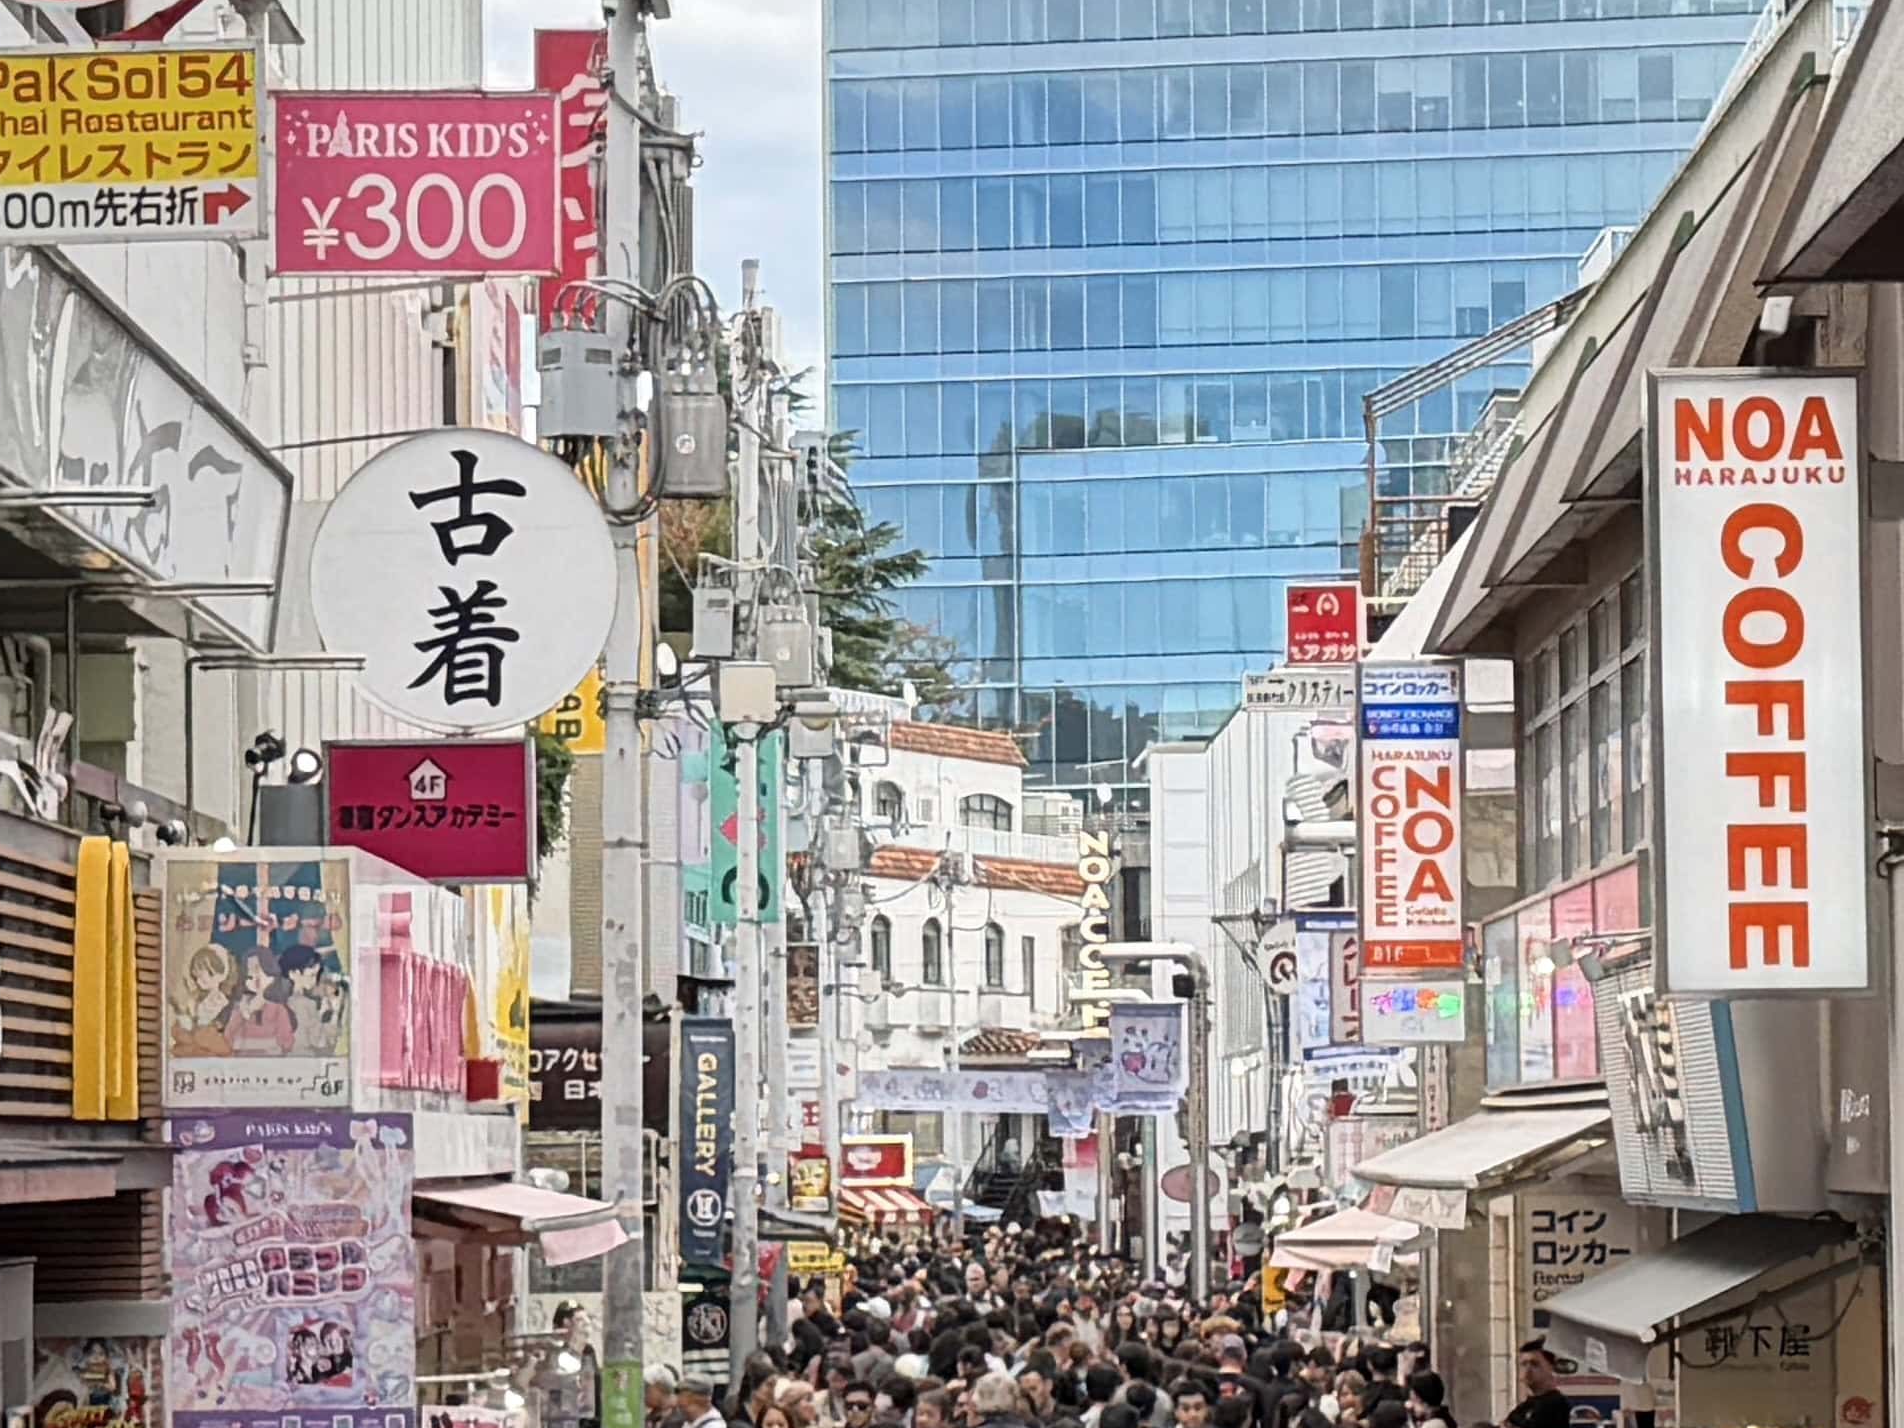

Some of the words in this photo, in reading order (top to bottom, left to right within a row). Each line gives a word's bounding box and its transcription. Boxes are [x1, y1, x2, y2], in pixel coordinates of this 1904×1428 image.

[86, 57, 167, 100] Soi
[178, 52, 251, 99] 54
[60, 104, 253, 135] Restaurant
[307, 110, 418, 158] PARIS
[427, 122, 529, 159] KID'S
[301, 172, 527, 260] ¥300
[1674, 396, 1843, 462] NOA
[1674, 465, 1847, 486] HARAJUKU
[407, 450, 527, 707] 古着
[1288, 680, 1354, 707] クリスティー
[1364, 682, 1450, 696] コインロッカー
[1371, 749, 1453, 762] HARAJUKU
[1720, 503, 1809, 969] COFFEE
[414, 774, 442, 795] 4F
[1371, 766, 1400, 926] COFFEE
[1403, 766, 1454, 902] NOA
[696, 1052, 717, 1177] GALLERY
[1532, 1210, 1607, 1235] コイン
[1533, 1240, 1631, 1266] ロッカー
[1705, 1325, 1811, 1359] 靴下屋
